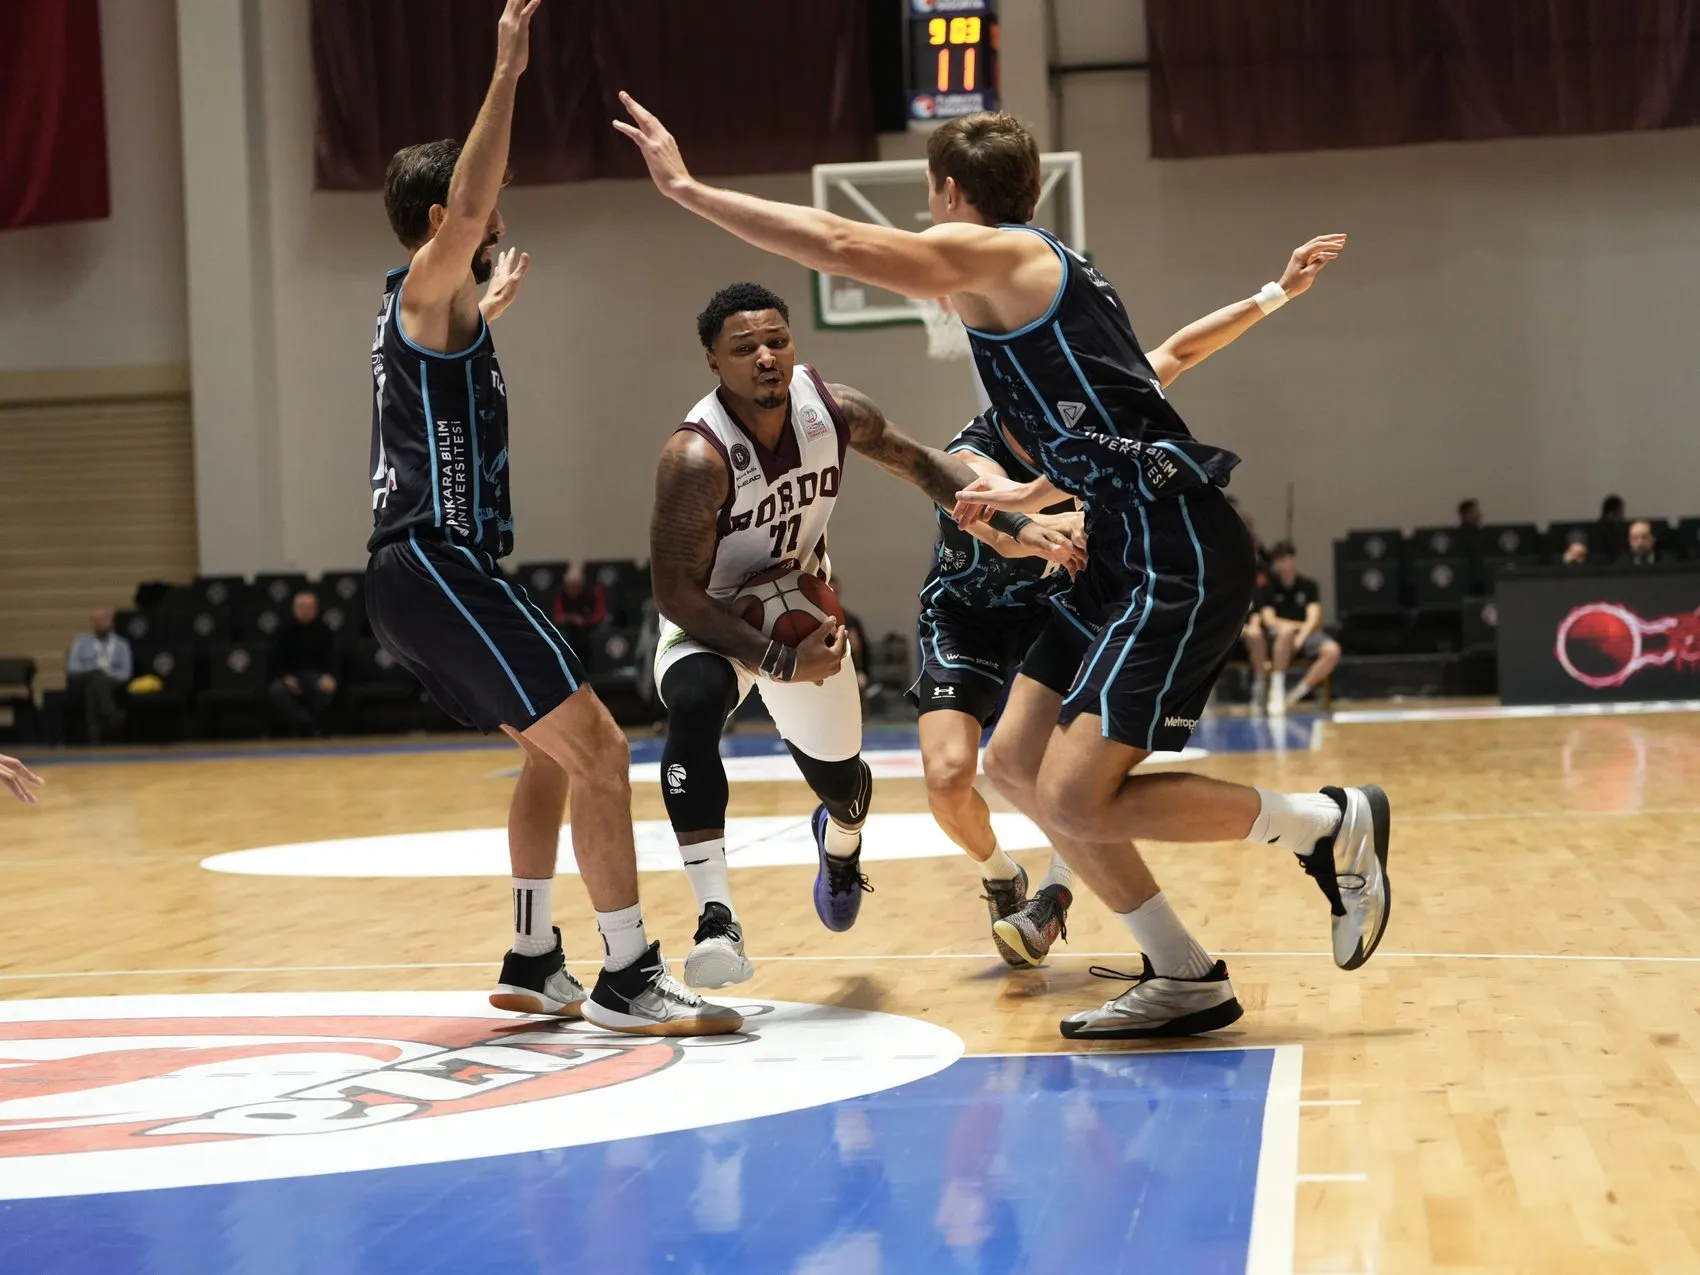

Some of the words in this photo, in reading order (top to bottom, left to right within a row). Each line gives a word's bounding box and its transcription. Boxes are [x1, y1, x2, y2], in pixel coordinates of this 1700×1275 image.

[938, 48, 975, 92] 11
[437, 420, 452, 461] BİLİM
[736, 452, 744, 463] B
[731, 466, 840, 531] BORDO
[769, 513, 802, 559] 77
